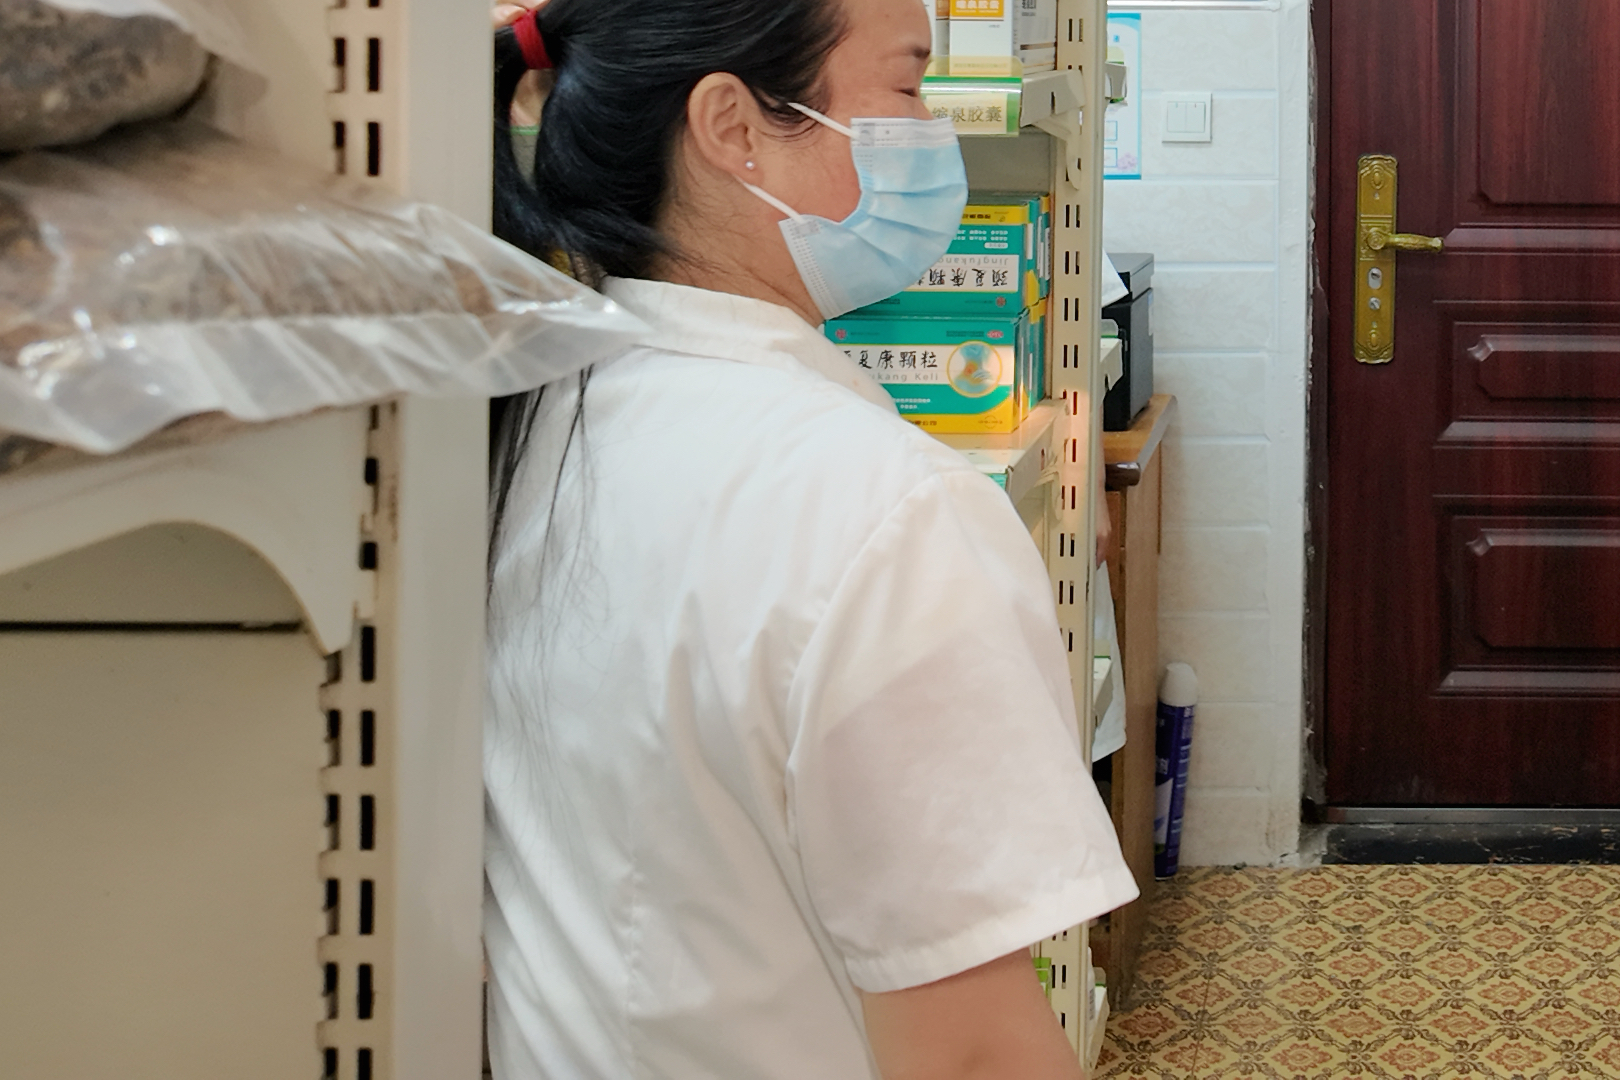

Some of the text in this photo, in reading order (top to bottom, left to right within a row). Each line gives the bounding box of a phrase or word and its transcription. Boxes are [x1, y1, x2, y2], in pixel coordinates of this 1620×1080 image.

[932, 106, 1002, 122] 缩泉胶囊
[920, 267, 1008, 288] 颈复康颗
[842, 350, 938, 370] 复康颗粒
[915, 371, 939, 381] Keli
